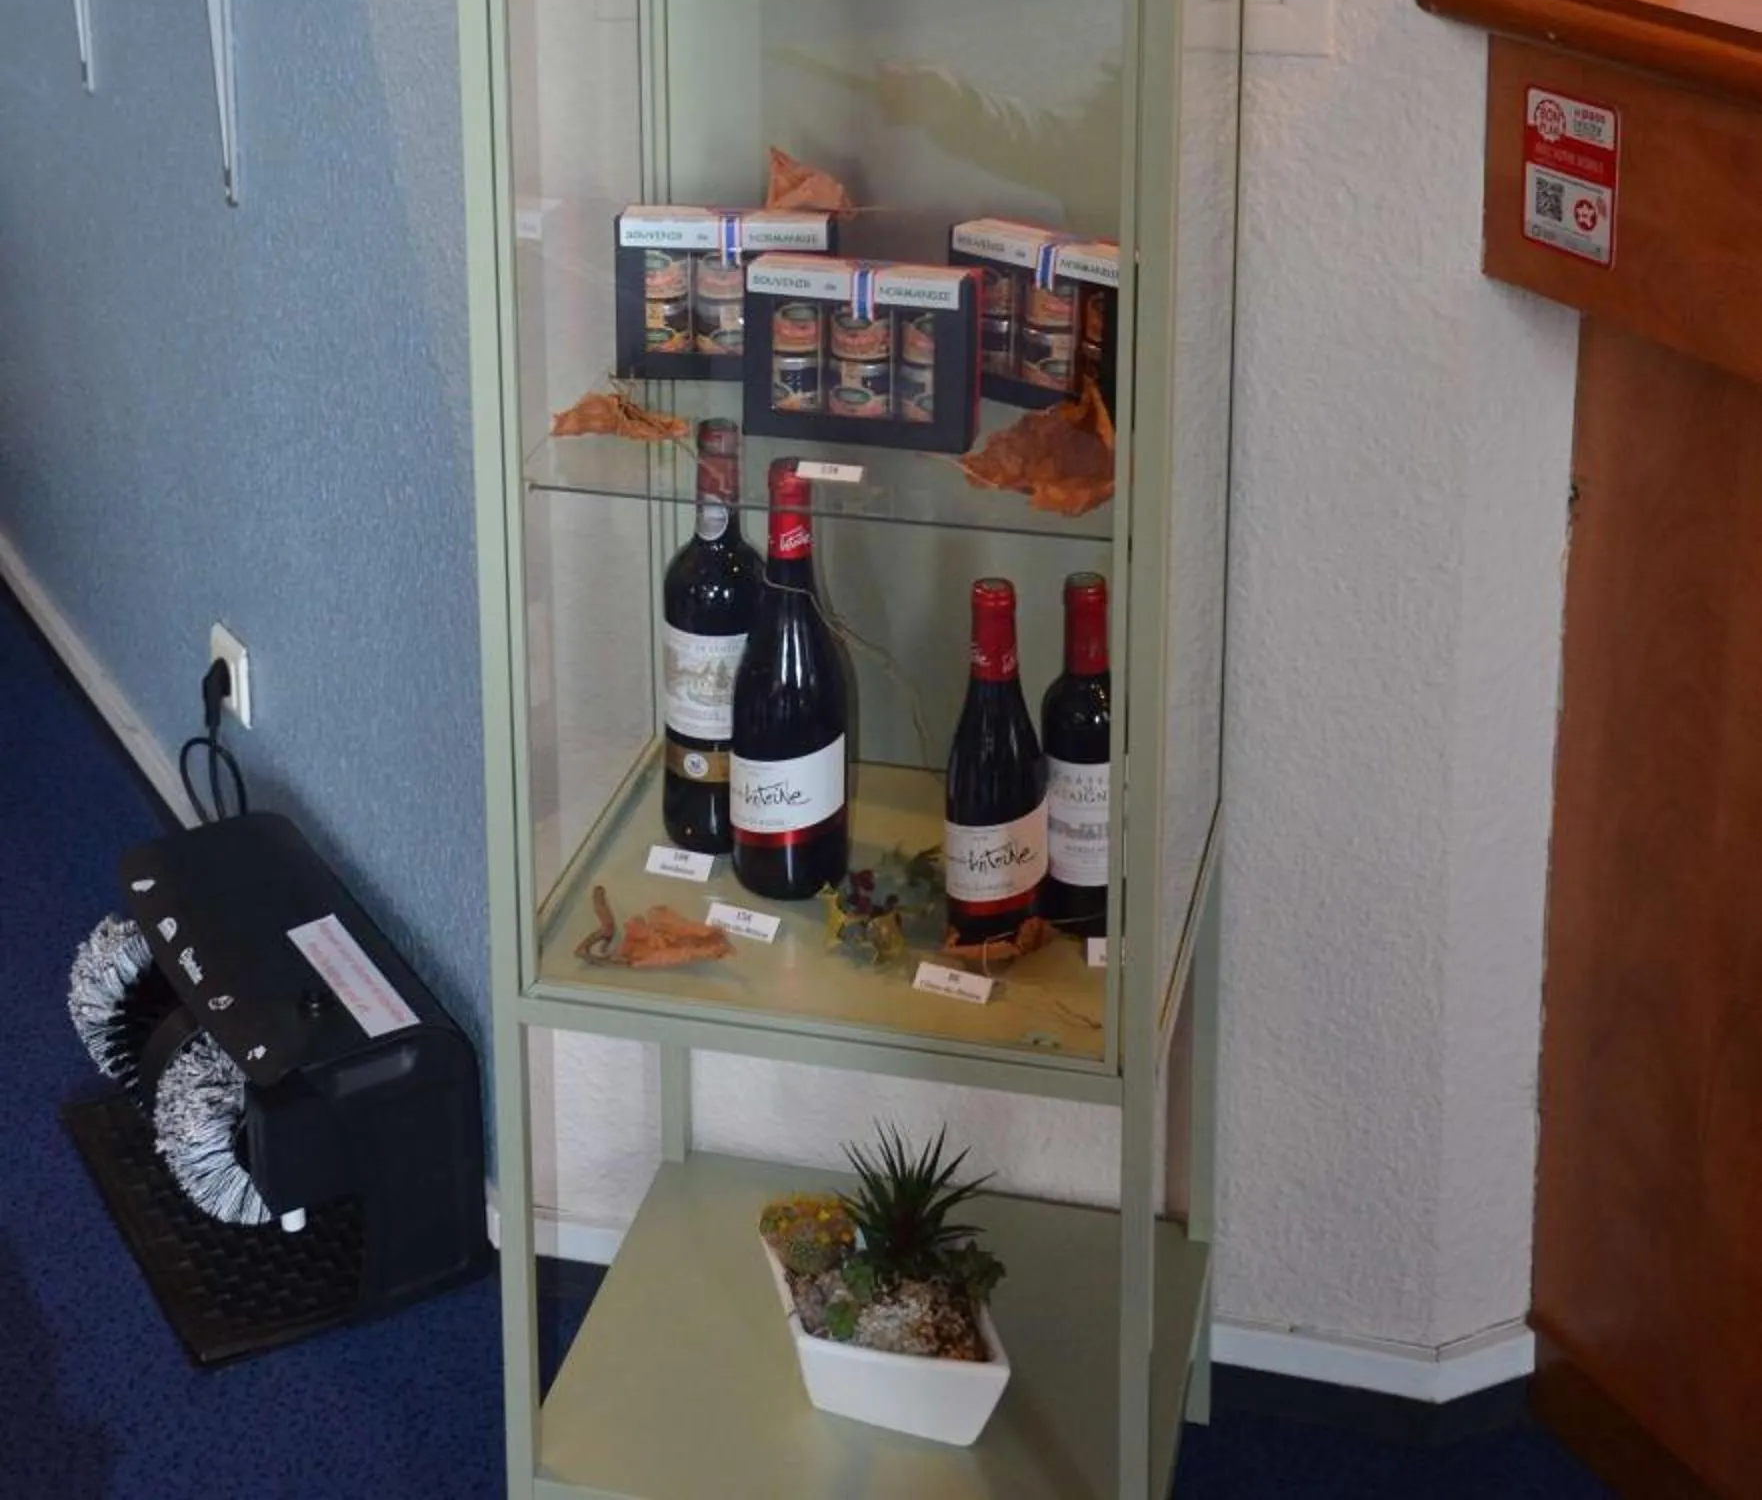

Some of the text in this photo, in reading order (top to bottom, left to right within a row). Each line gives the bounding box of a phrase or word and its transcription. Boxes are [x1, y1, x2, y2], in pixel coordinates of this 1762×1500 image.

[624, 229, 684, 242] SOUVENIR
[748, 232, 819, 244] NORMANDIE
[752, 275, 812, 290] SOUVENIR
[879, 286, 951, 302] NORMANDIE
